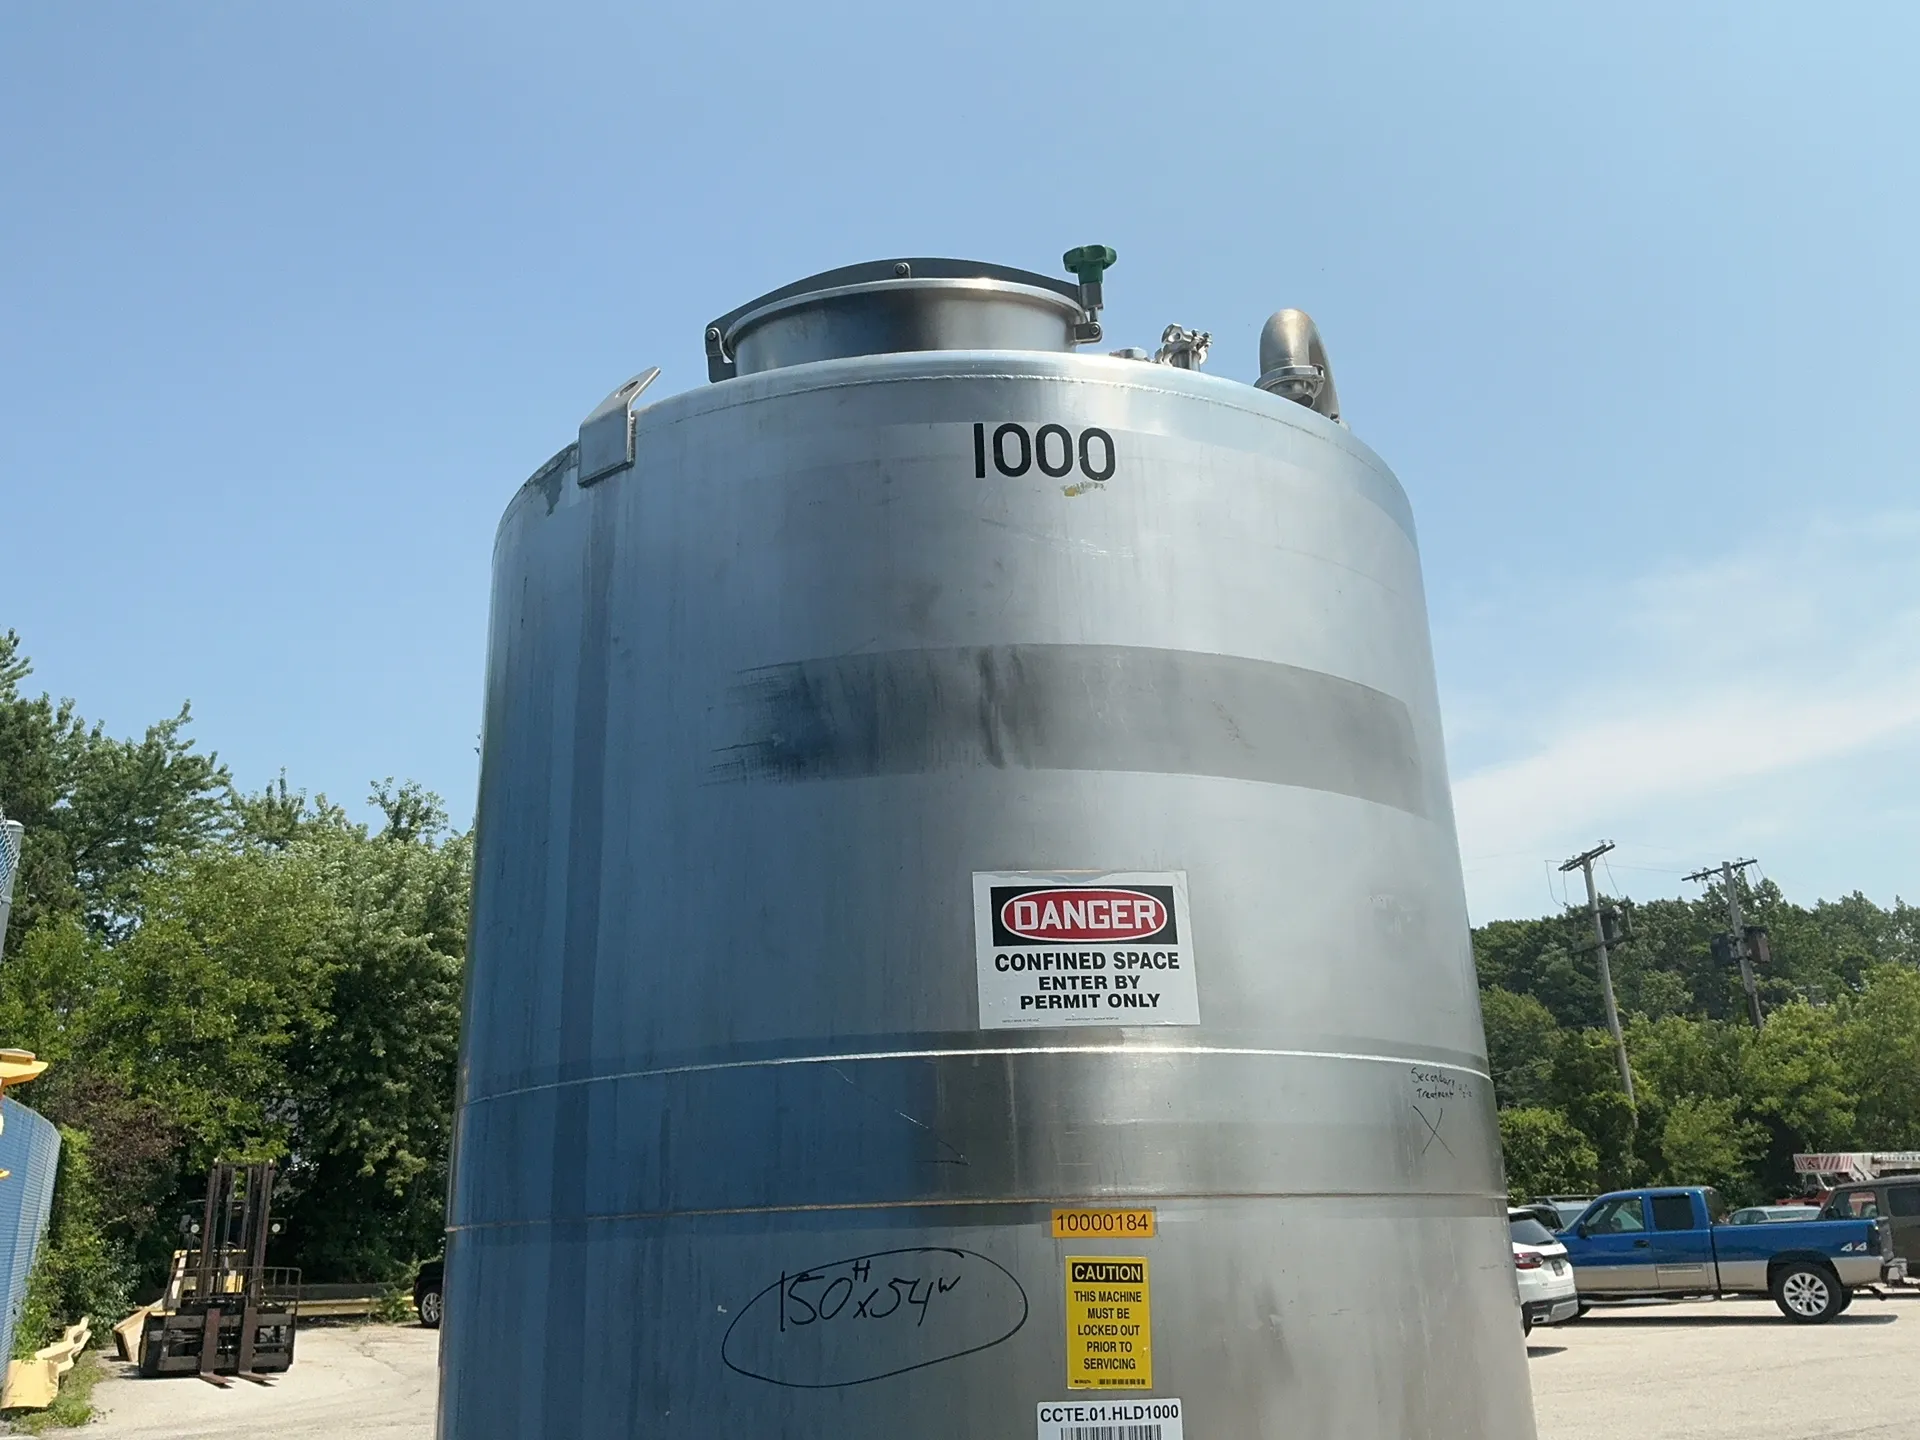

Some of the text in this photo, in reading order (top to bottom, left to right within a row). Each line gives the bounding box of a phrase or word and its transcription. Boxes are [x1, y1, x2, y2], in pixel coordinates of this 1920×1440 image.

[973, 422, 1116, 482] 1000
[1013, 899, 1157, 931] DANGER
[994, 951, 1180, 972] CONFINED SPACE
[1038, 974, 1141, 991] ENTER BY
[1020, 993, 1161, 1010] PERMIT ONLY
[1056, 1213, 1149, 1232] 10000184
[1840, 1241, 1867, 1252] 44
[1074, 1264, 1142, 1281] CAUTION
[1074, 1291, 1142, 1303] THIS MACHINE
[1087, 1307, 1130, 1320] MUST BE
[1077, 1324, 1141, 1336] LOCKED OUT
[1086, 1341, 1133, 1353] PRIOR TO
[1083, 1358, 1136, 1370] SERVICING
[1040, 1404, 1179, 1423] CCTE.01.HLD1000
